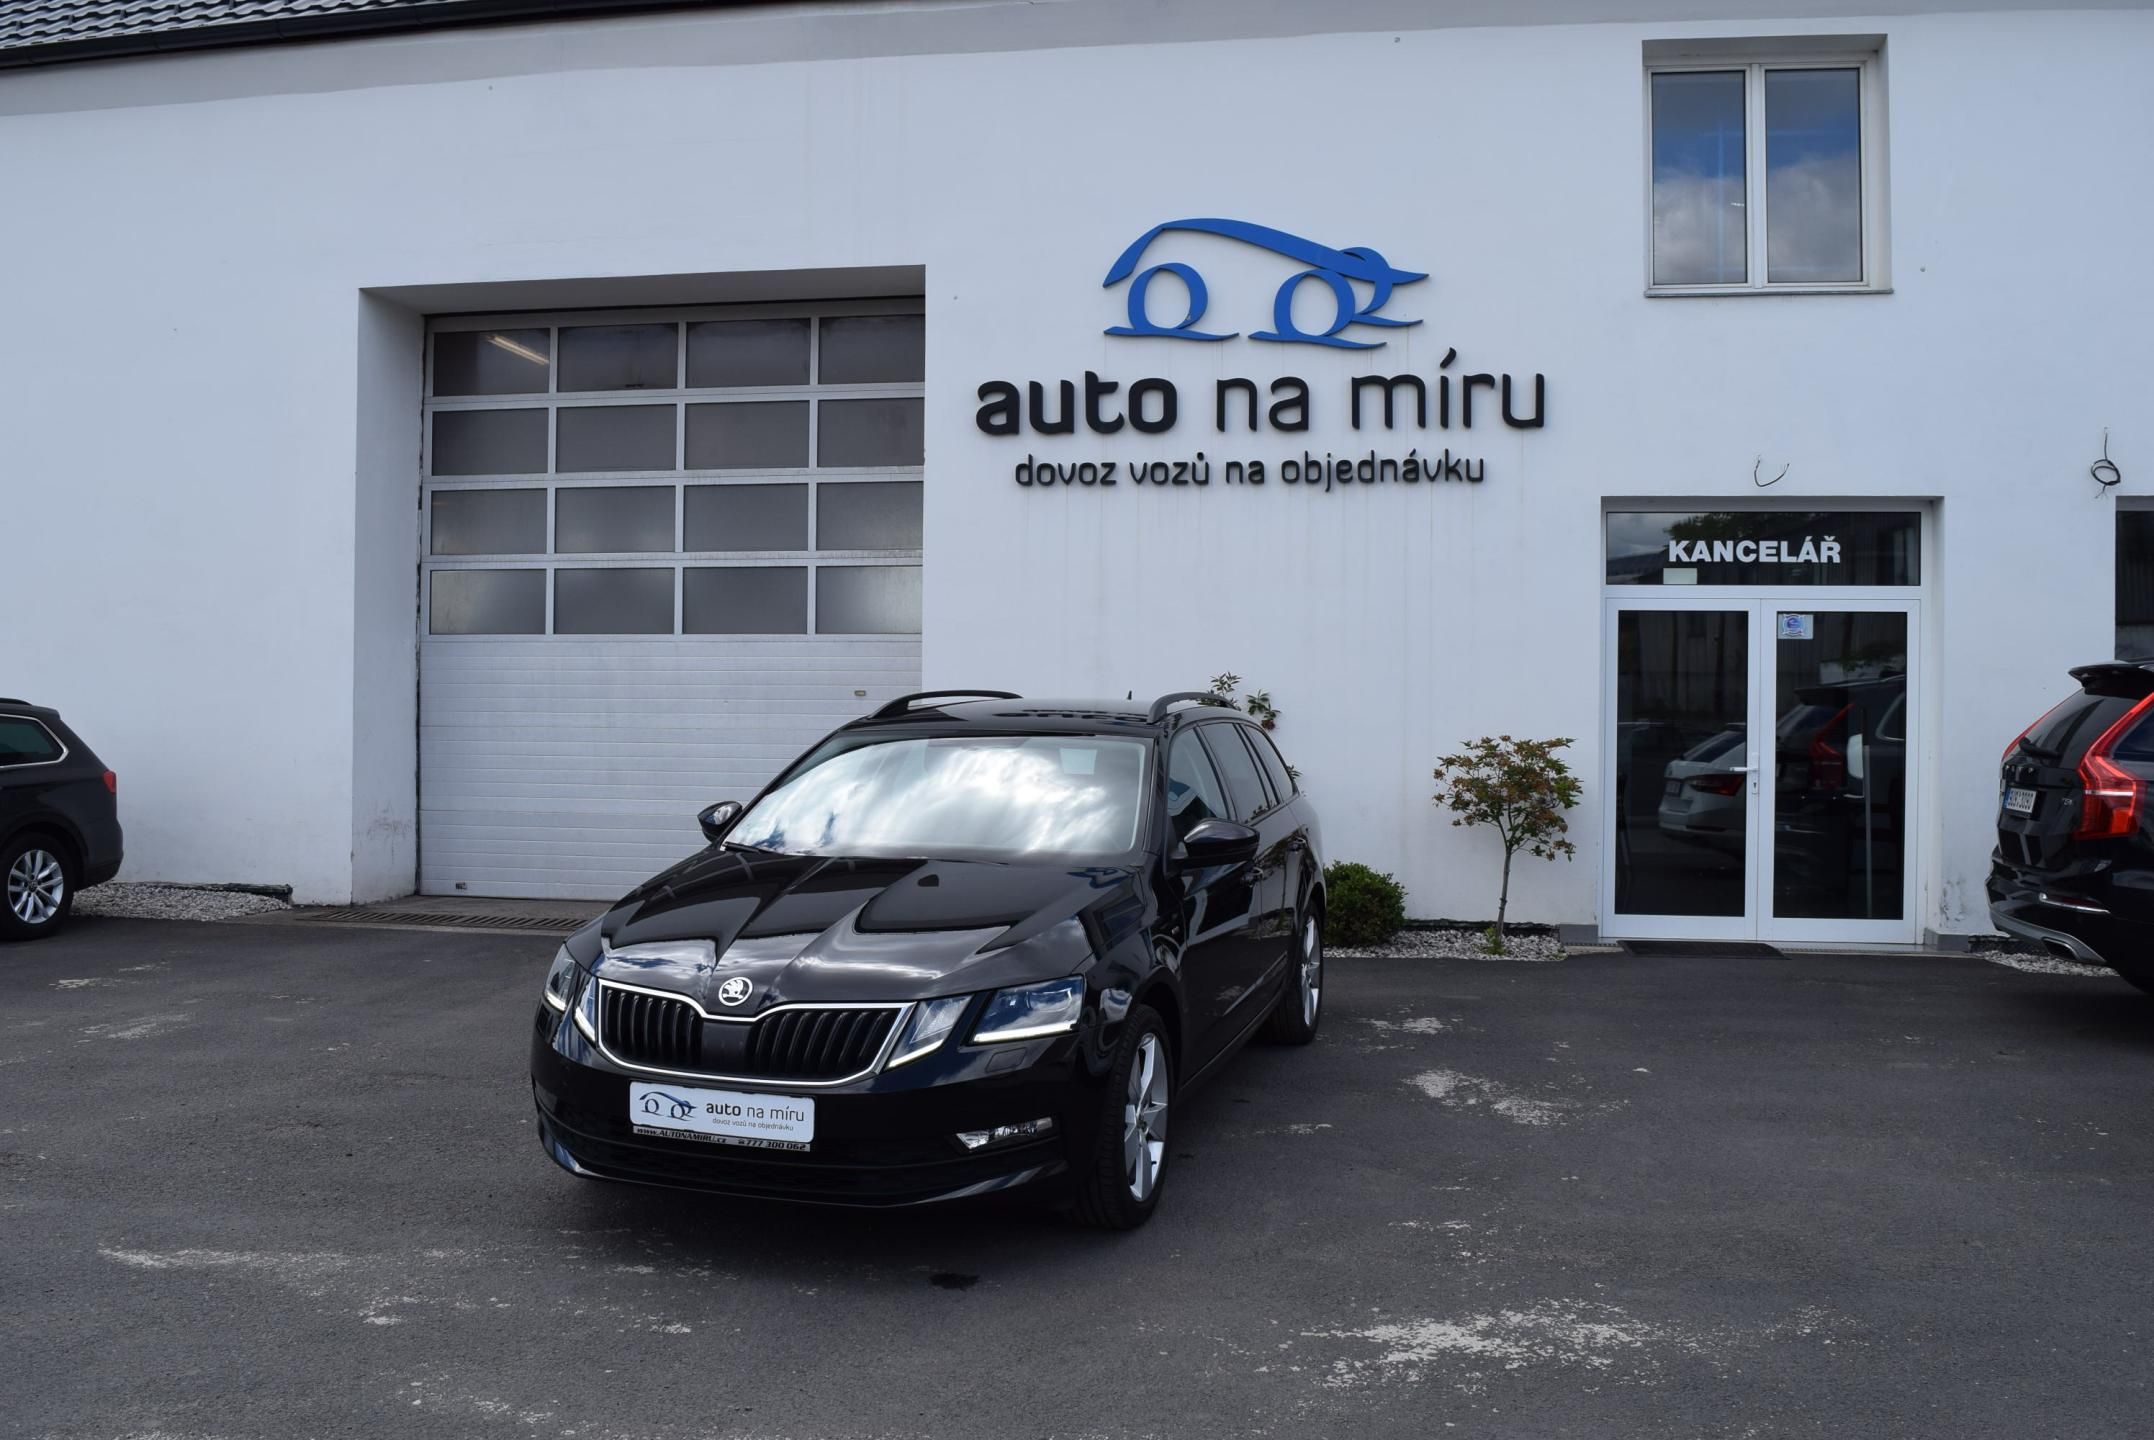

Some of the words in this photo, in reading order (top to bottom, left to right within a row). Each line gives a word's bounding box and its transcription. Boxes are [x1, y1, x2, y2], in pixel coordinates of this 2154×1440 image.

[975, 369, 1179, 438] auto
[1216, 376, 1310, 434] na
[1351, 346, 1546, 431] míru
[1015, 453, 1117, 488] dovoz
[1129, 451, 1210, 487] vozů
[1225, 460, 1265, 487] na
[1281, 448, 1484, 493] objednávku
[1668, 535, 1841, 563] KANCELÁŘ
[706, 1102, 742, 1117] auto
[747, 1106, 764, 1119] na
[770, 1105, 804, 1122] míru
[712, 1117, 731, 1126] dovoz
[757, 1121, 794, 1132] objednávku
[767, 1141, 785, 1149] 300
